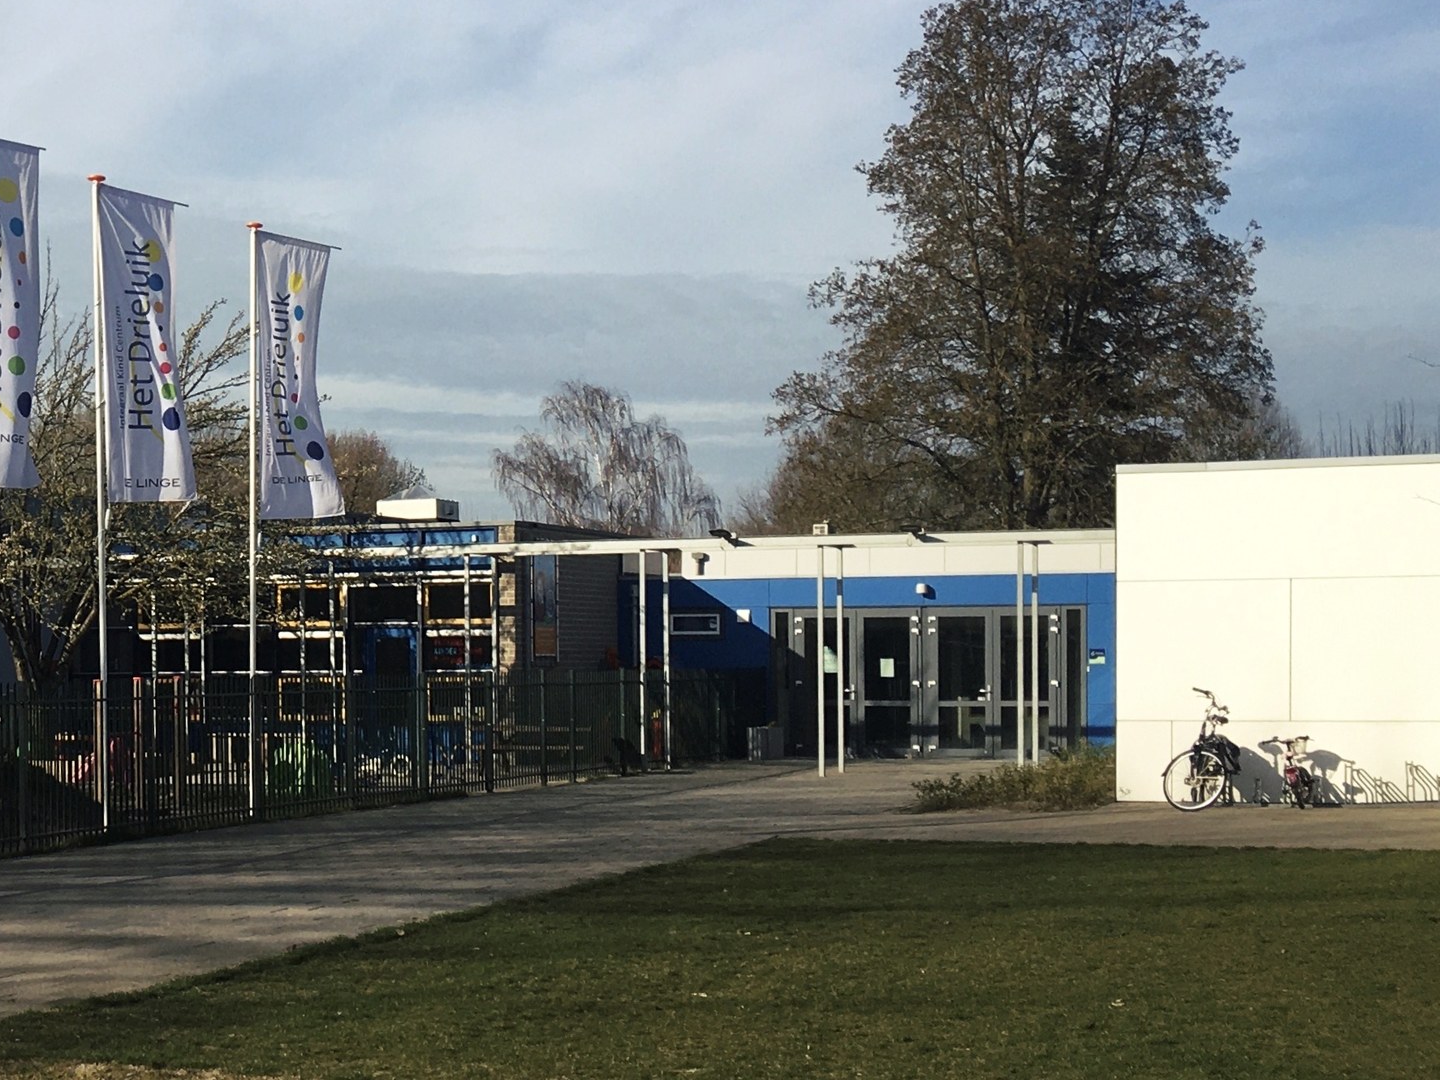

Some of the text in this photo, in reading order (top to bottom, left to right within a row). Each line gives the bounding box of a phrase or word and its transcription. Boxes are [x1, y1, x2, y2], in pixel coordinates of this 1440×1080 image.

[125, 240, 154, 430] Het Drieluik
[116, 356, 125, 379] Kind
[271, 292, 296, 457] Het Drieluik
[136, 477, 181, 488] LINGE
[272, 474, 323, 485] DE LINGE
